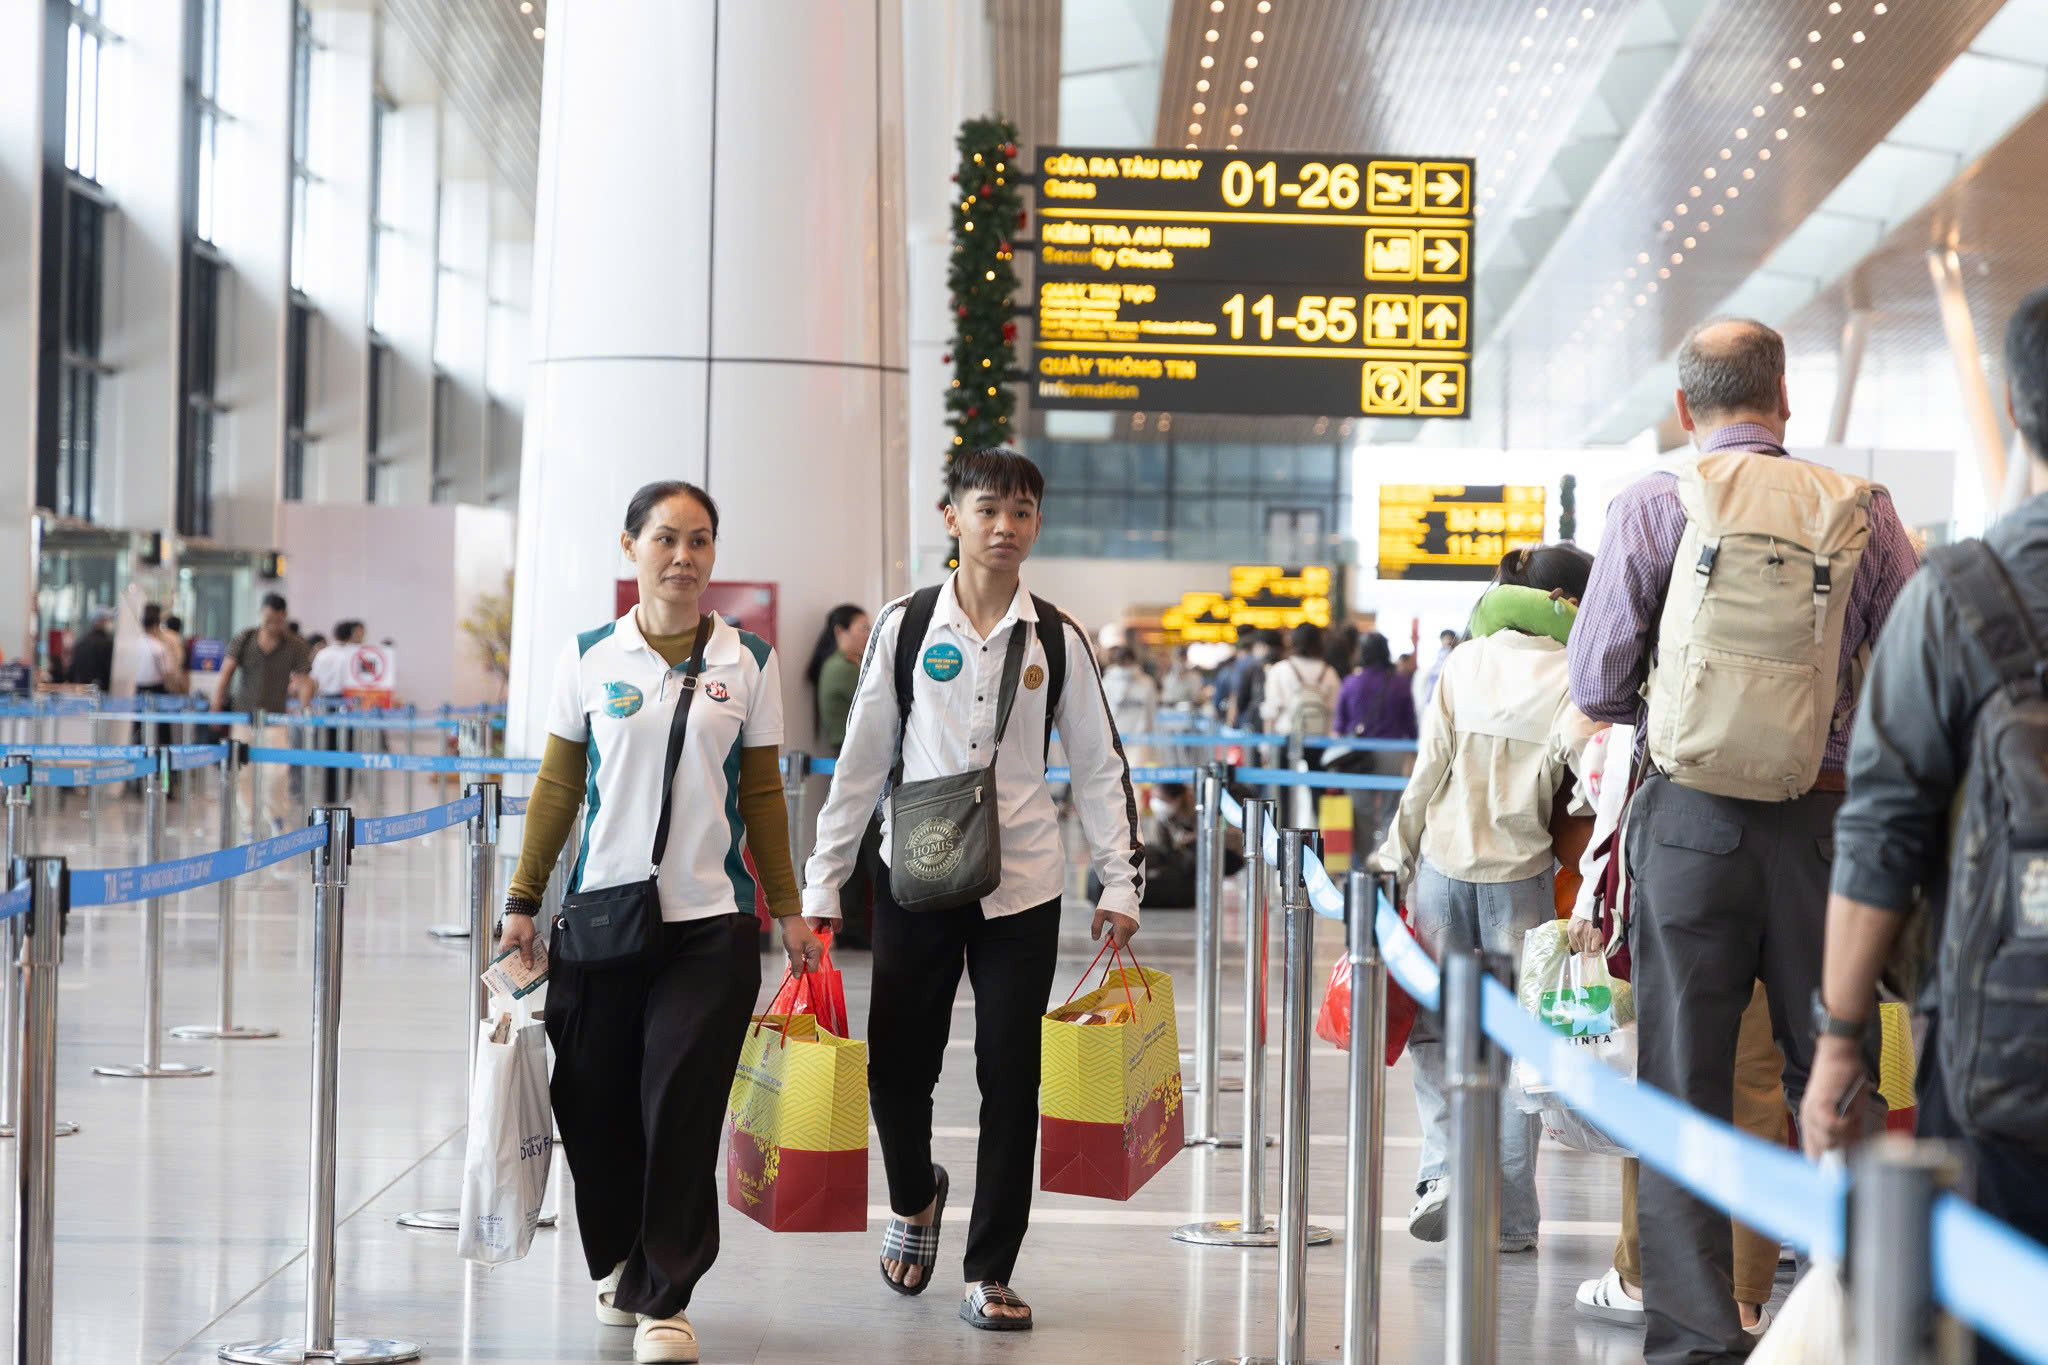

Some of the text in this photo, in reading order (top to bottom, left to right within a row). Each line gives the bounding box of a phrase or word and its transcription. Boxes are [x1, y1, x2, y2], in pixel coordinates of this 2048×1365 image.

[1222, 160, 1360, 210] 01-26
[1222, 293, 1358, 342] 11-55
[912, 839, 954, 859] HOMIS
[520, 1141, 543, 1160] Duty
